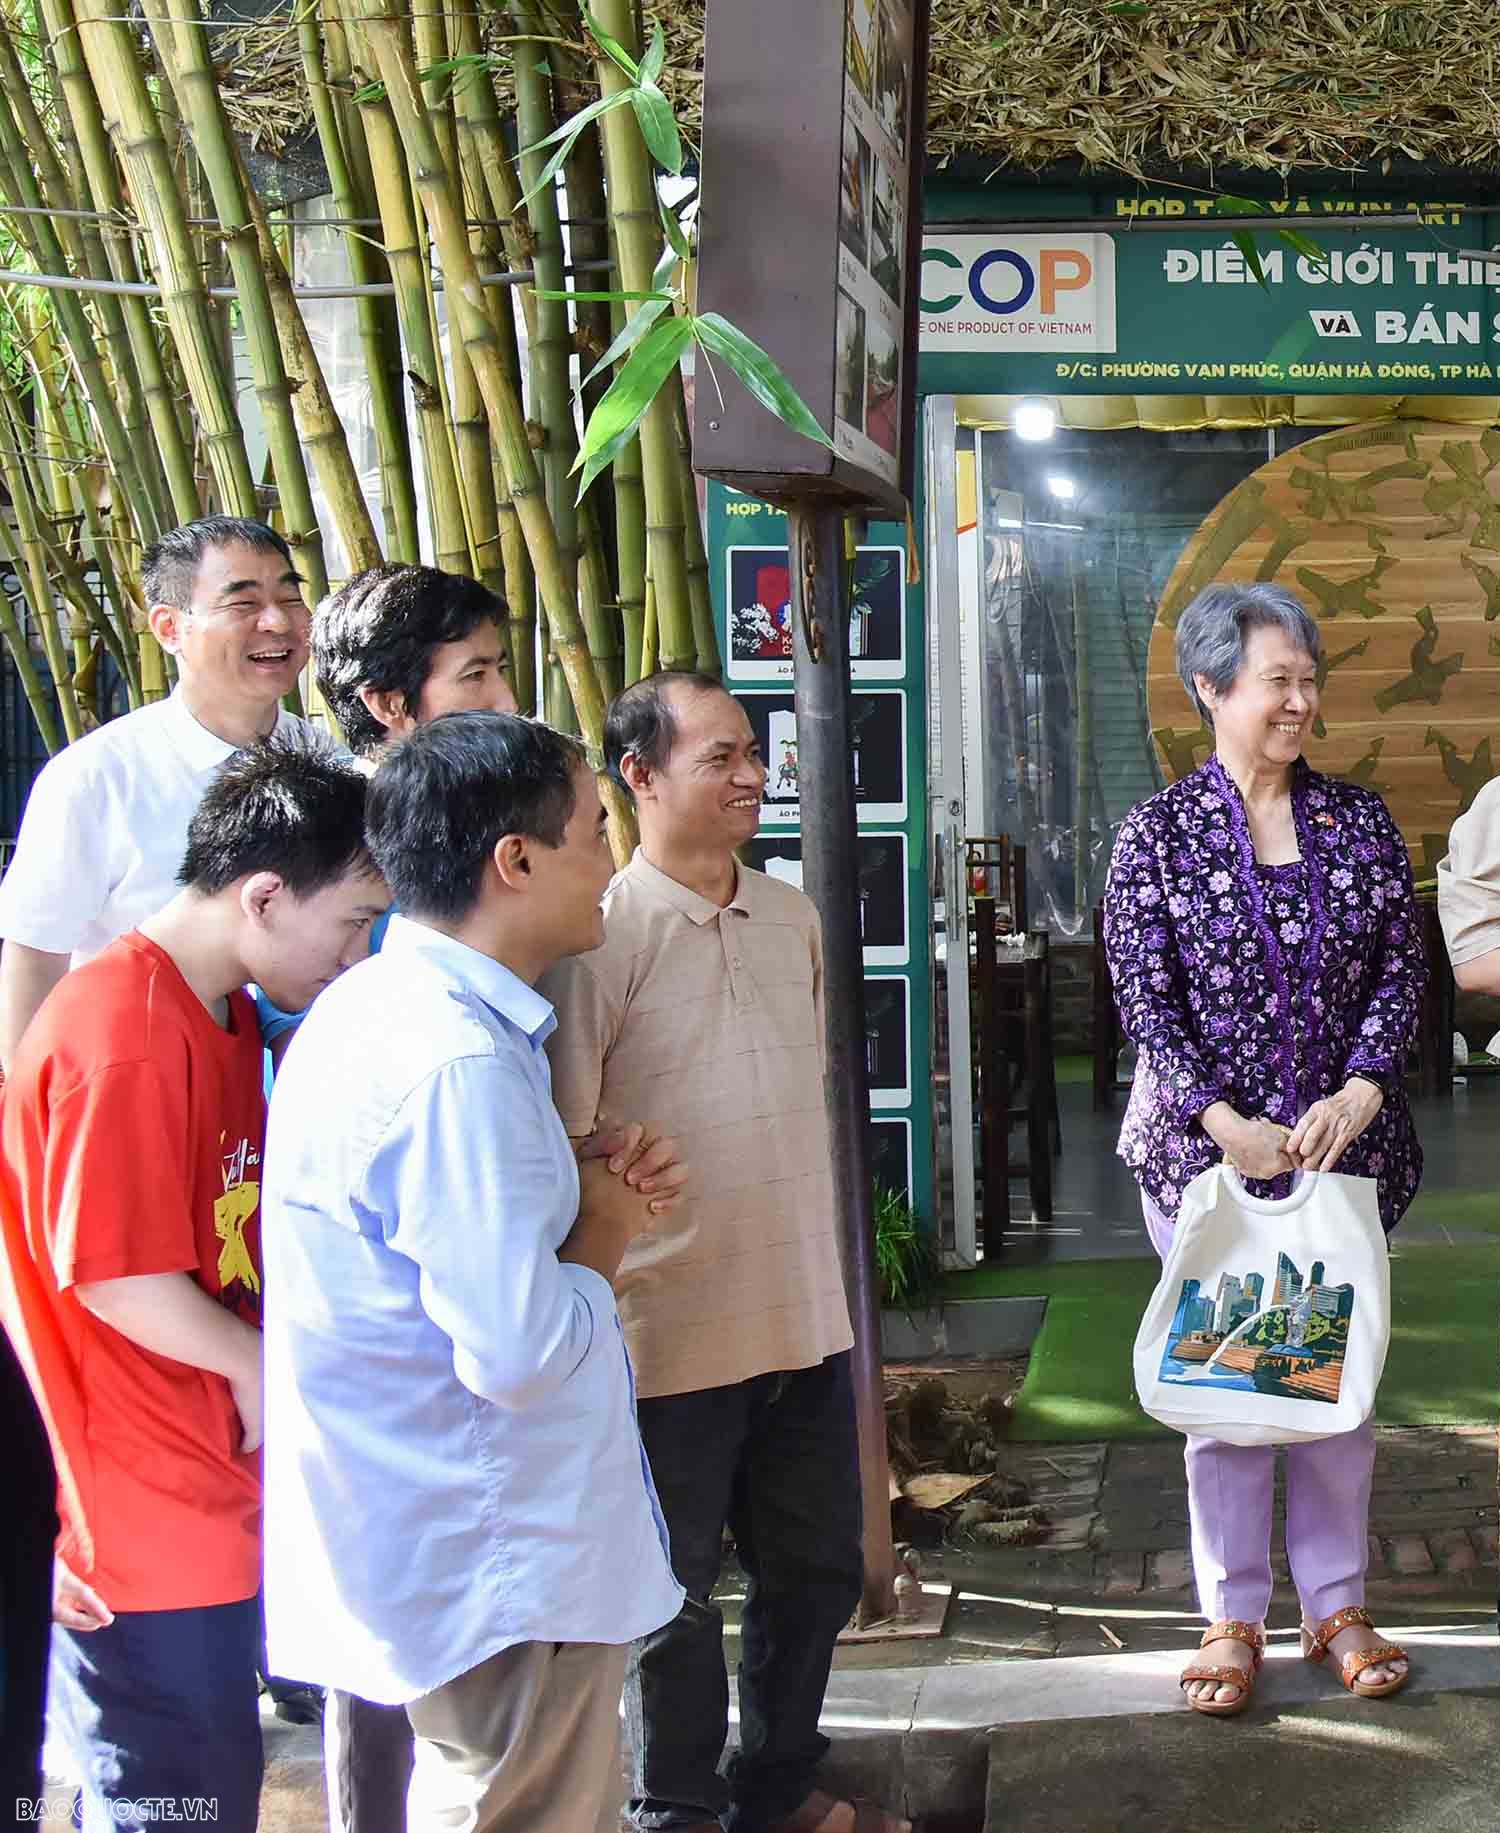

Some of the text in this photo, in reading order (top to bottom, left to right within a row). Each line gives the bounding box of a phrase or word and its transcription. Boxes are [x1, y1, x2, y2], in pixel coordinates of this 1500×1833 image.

[1295, 242, 1394, 285] GIỚI
[928, 321, 954, 334] ONE
[958, 321, 1014, 334] PRODUCT
[1018, 321, 1035, 334] OF
[1039, 321, 1092, 335] VIETNAM
[1319, 314, 1351, 334] VÀ
[1375, 302, 1480, 345] BÁN
[1055, 362, 1098, 379] Đ/C:
[1101, 360, 1181, 378] PHƯỜNG
[1229, 360, 1285, 381] PHÚC,
[1288, 361, 1343, 381] QUẬN
[1346, 361, 1370, 378] HÀ
[1377, 361, 1435, 380] ĐÔNG,
[1439, 364, 1462, 378] TP
[1466, 361, 1492, 378] HÀ
